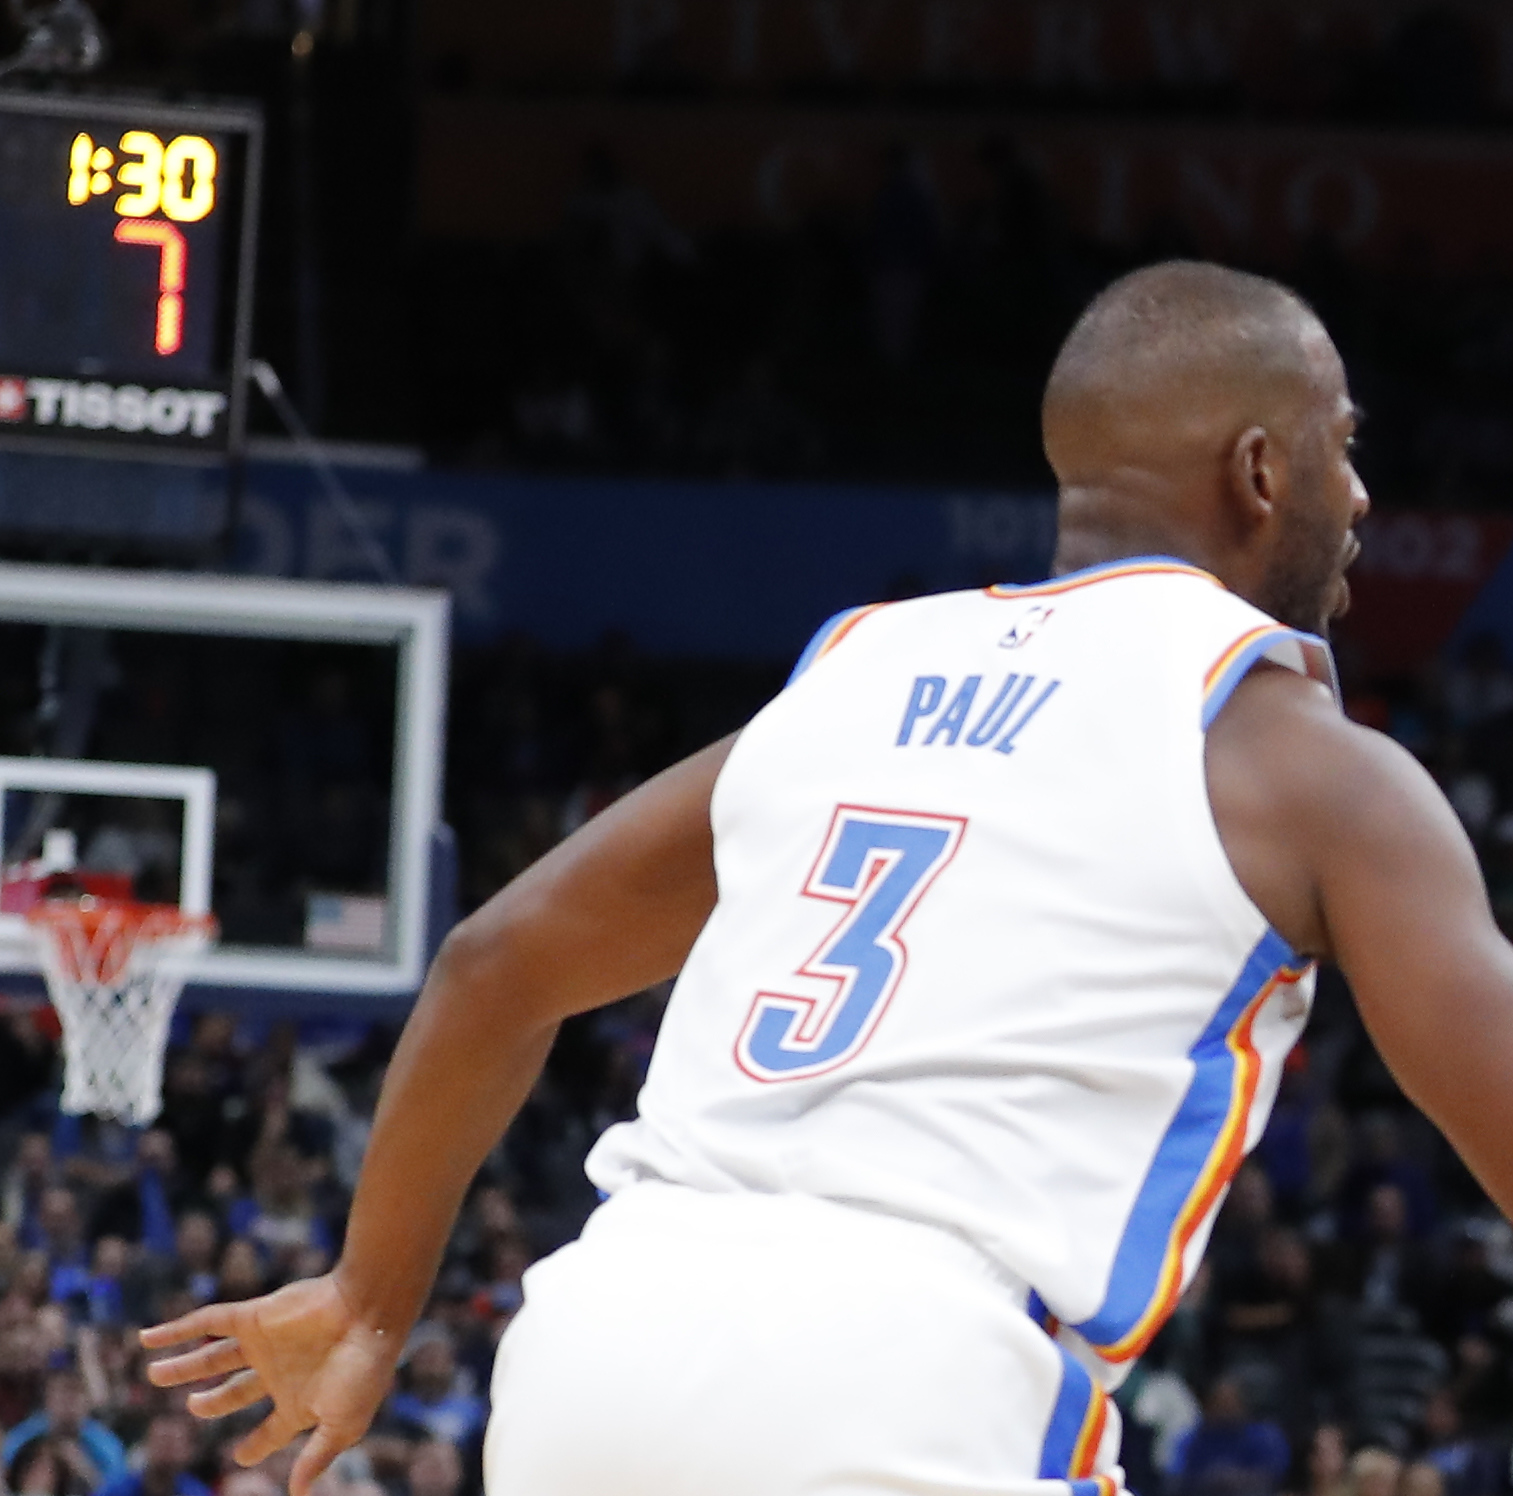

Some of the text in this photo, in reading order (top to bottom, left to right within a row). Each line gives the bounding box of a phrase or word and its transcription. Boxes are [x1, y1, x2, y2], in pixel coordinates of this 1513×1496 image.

[67, 129, 217, 222] 1:30
[113, 217, 187, 356] 7
[24, 377, 228, 438] TISSOT
[895, 673, 1061, 755] PAUL
[733, 803, 970, 1084] 3
